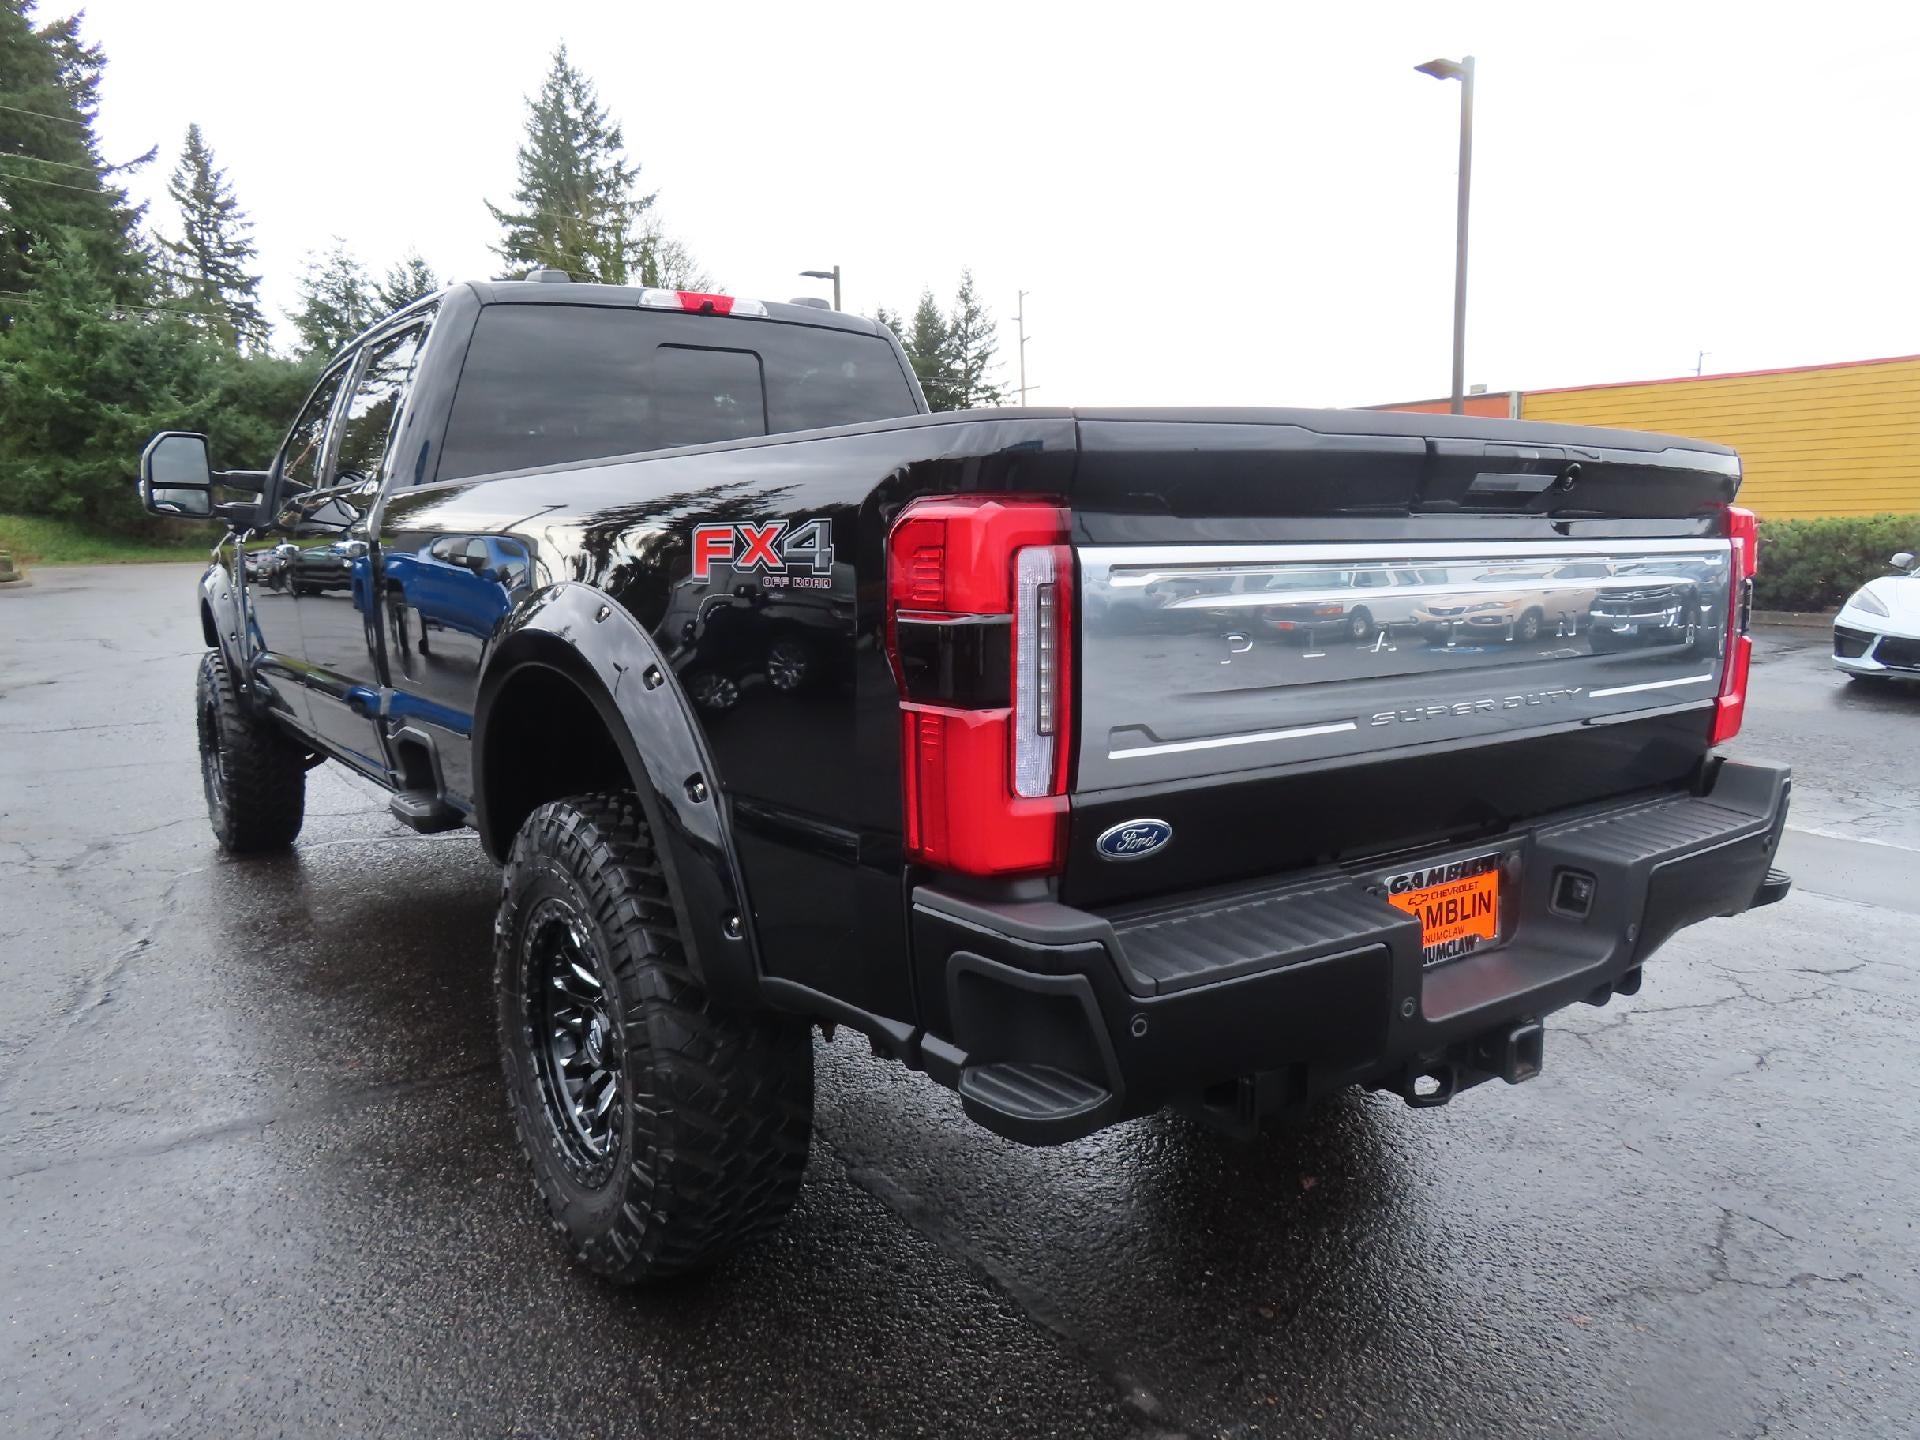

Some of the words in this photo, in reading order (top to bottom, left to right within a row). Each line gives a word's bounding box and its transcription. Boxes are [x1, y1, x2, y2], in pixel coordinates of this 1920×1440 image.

[692, 518, 834, 584] FX4
[763, 576, 790, 588] OFF
[793, 577, 832, 589] ROAD
[1370, 698, 1495, 727] SUPER
[1502, 687, 1583, 709] DUTY
[1116, 827, 1159, 852] Ford
[1430, 880, 1480, 900] CHEVROLET
